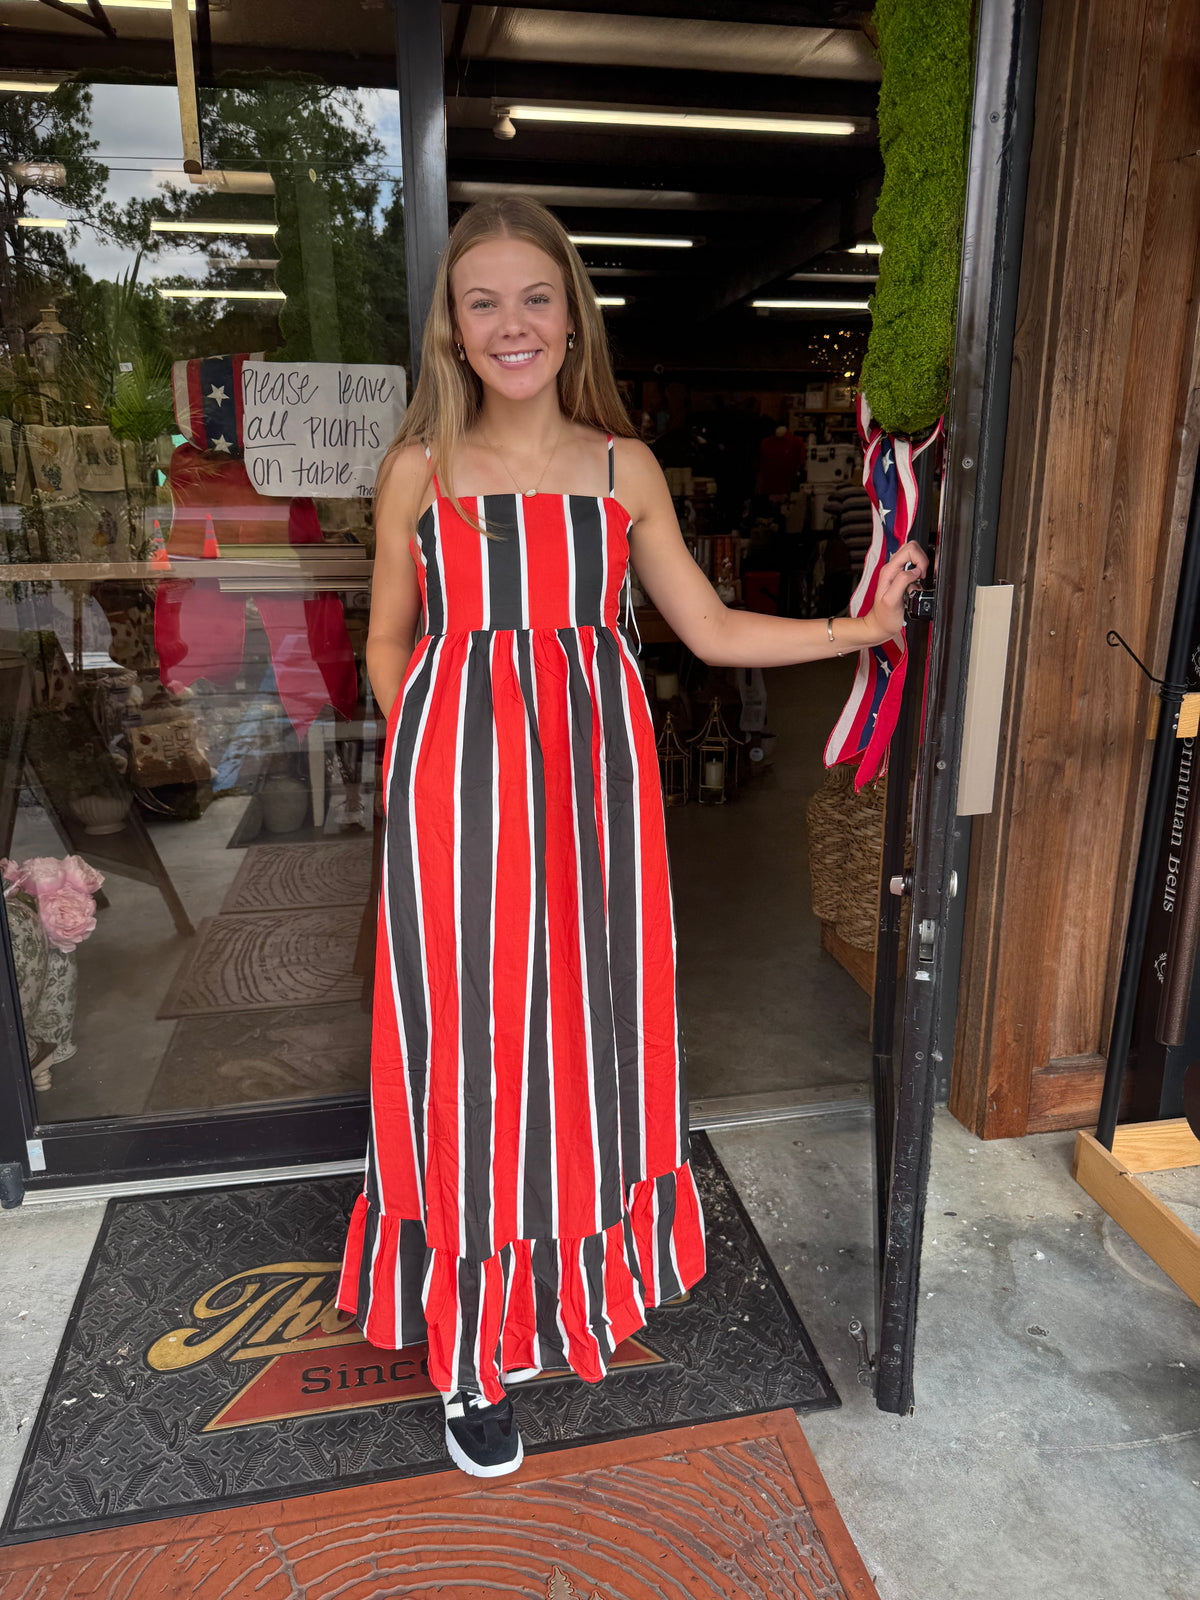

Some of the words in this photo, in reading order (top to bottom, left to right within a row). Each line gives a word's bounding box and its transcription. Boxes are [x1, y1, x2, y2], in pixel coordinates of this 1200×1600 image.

[242, 368, 318, 406] Please
[338, 370, 394, 405] leave
[247, 410, 289, 441] all
[252, 456, 282, 486] on
[291, 457, 357, 486] table.
[1171, 736, 1195, 847] orinthian
[1163, 852, 1181, 913] Bells
